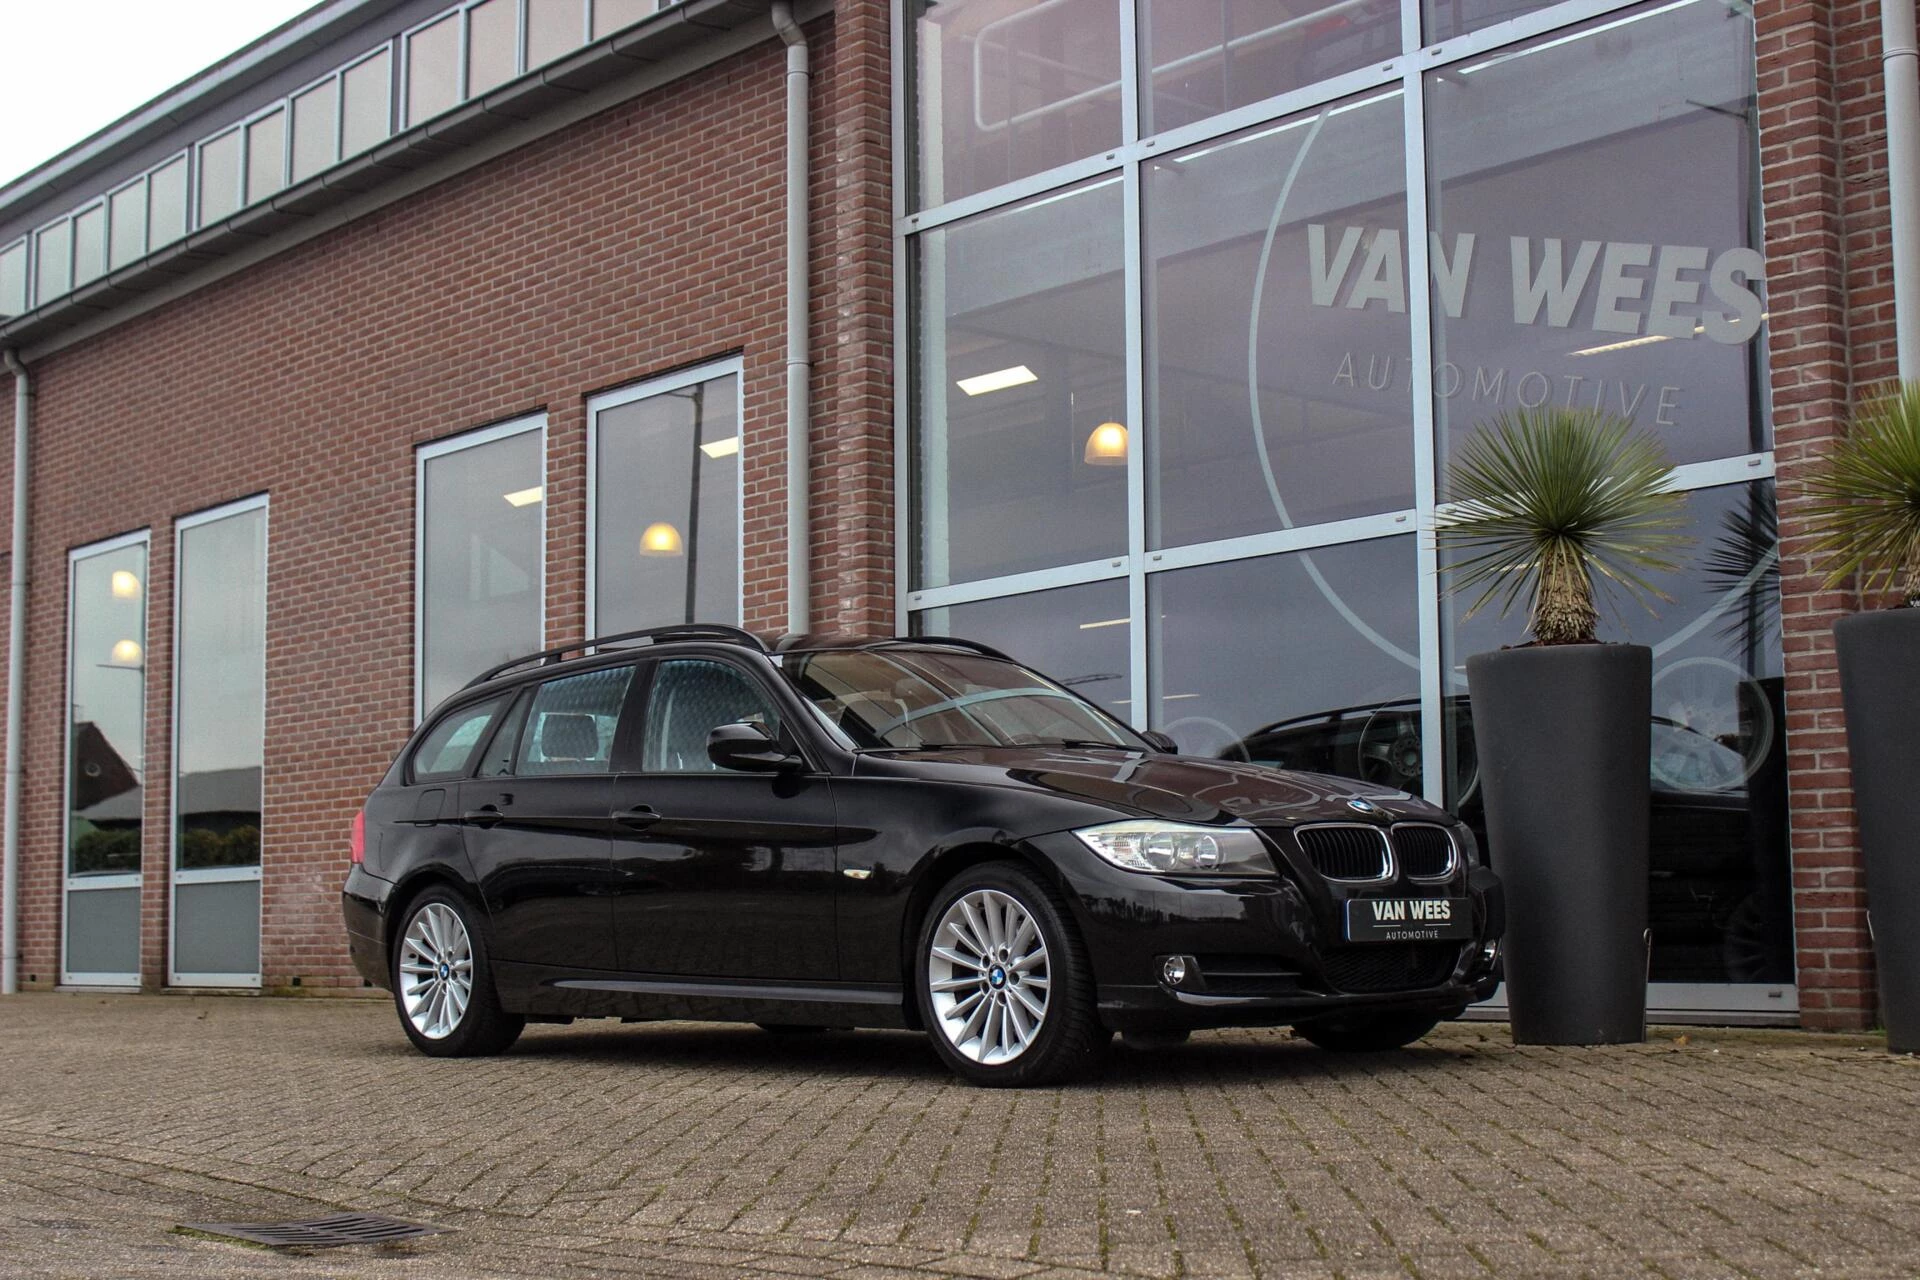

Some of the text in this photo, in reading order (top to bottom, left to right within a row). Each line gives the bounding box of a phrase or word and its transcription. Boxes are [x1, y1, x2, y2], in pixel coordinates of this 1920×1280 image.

[1307, 223, 1766, 345] VAN WEES
[1372, 900, 1451, 921] VAN WEES
[1386, 930, 1439, 940] AUTOMOTIVE
